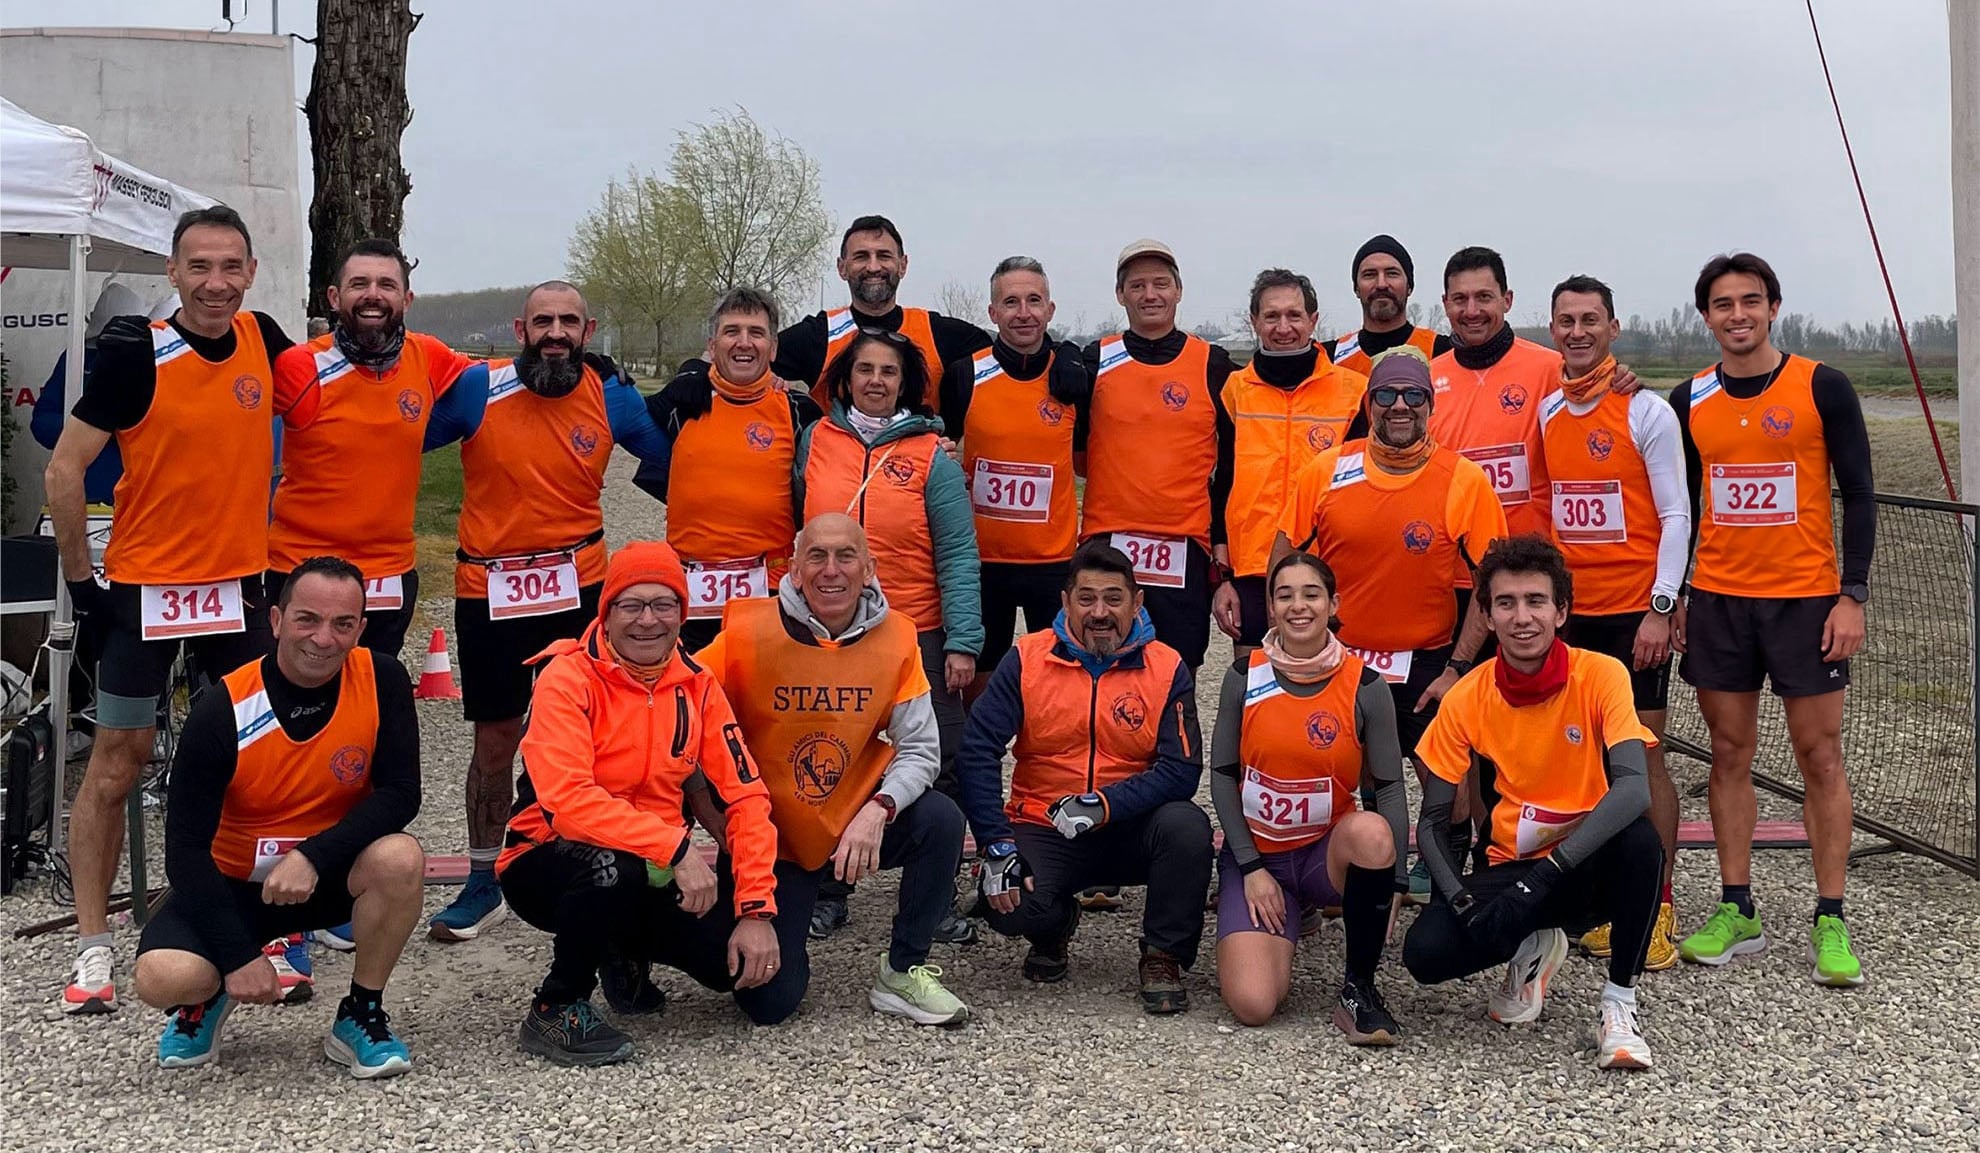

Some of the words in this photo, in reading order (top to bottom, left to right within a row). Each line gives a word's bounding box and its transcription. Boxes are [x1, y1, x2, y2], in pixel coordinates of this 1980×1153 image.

[1482, 462, 1514, 489] 05
[987, 477, 1036, 507] 310
[1727, 482, 1777, 510] 322
[1562, 498, 1607, 527] 303
[1125, 540, 1171, 571] 318
[505, 570, 561, 602] 304
[701, 573, 752, 603] 315
[162, 587, 224, 621] 314
[773, 686, 873, 712] STAFF
[1258, 791, 1310, 826] 321
